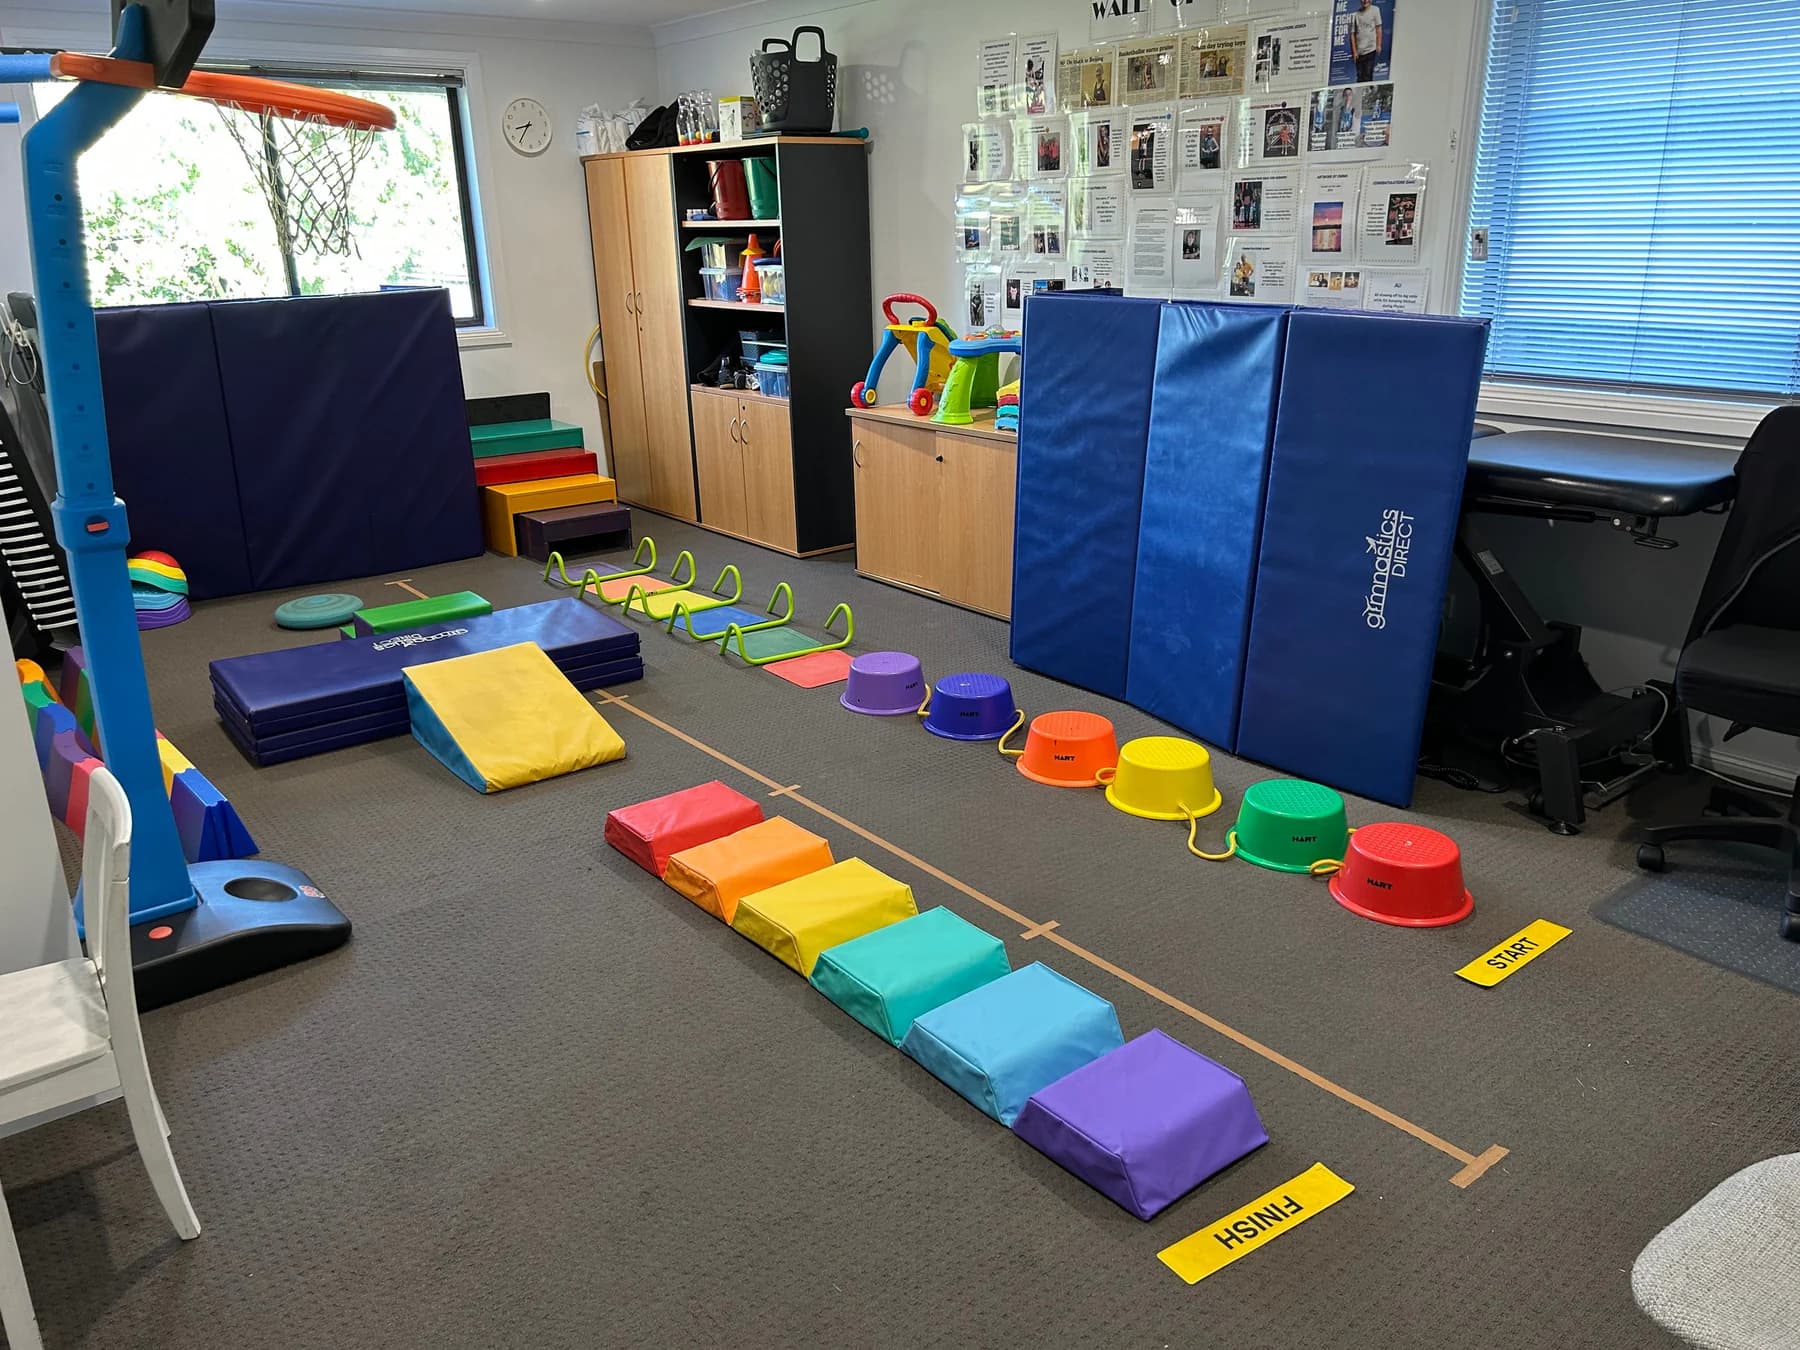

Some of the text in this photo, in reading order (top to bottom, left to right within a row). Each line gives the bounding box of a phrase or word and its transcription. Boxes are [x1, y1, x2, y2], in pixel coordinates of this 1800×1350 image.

[1092, 0, 1148, 20] WALL
[1391, 511, 1415, 578] DIRECT
[1363, 509, 1399, 629] gymnastics
[1367, 877, 1392, 890] HART
[1486, 937, 1540, 969] START
[1213, 1195, 1304, 1250] FINISH
